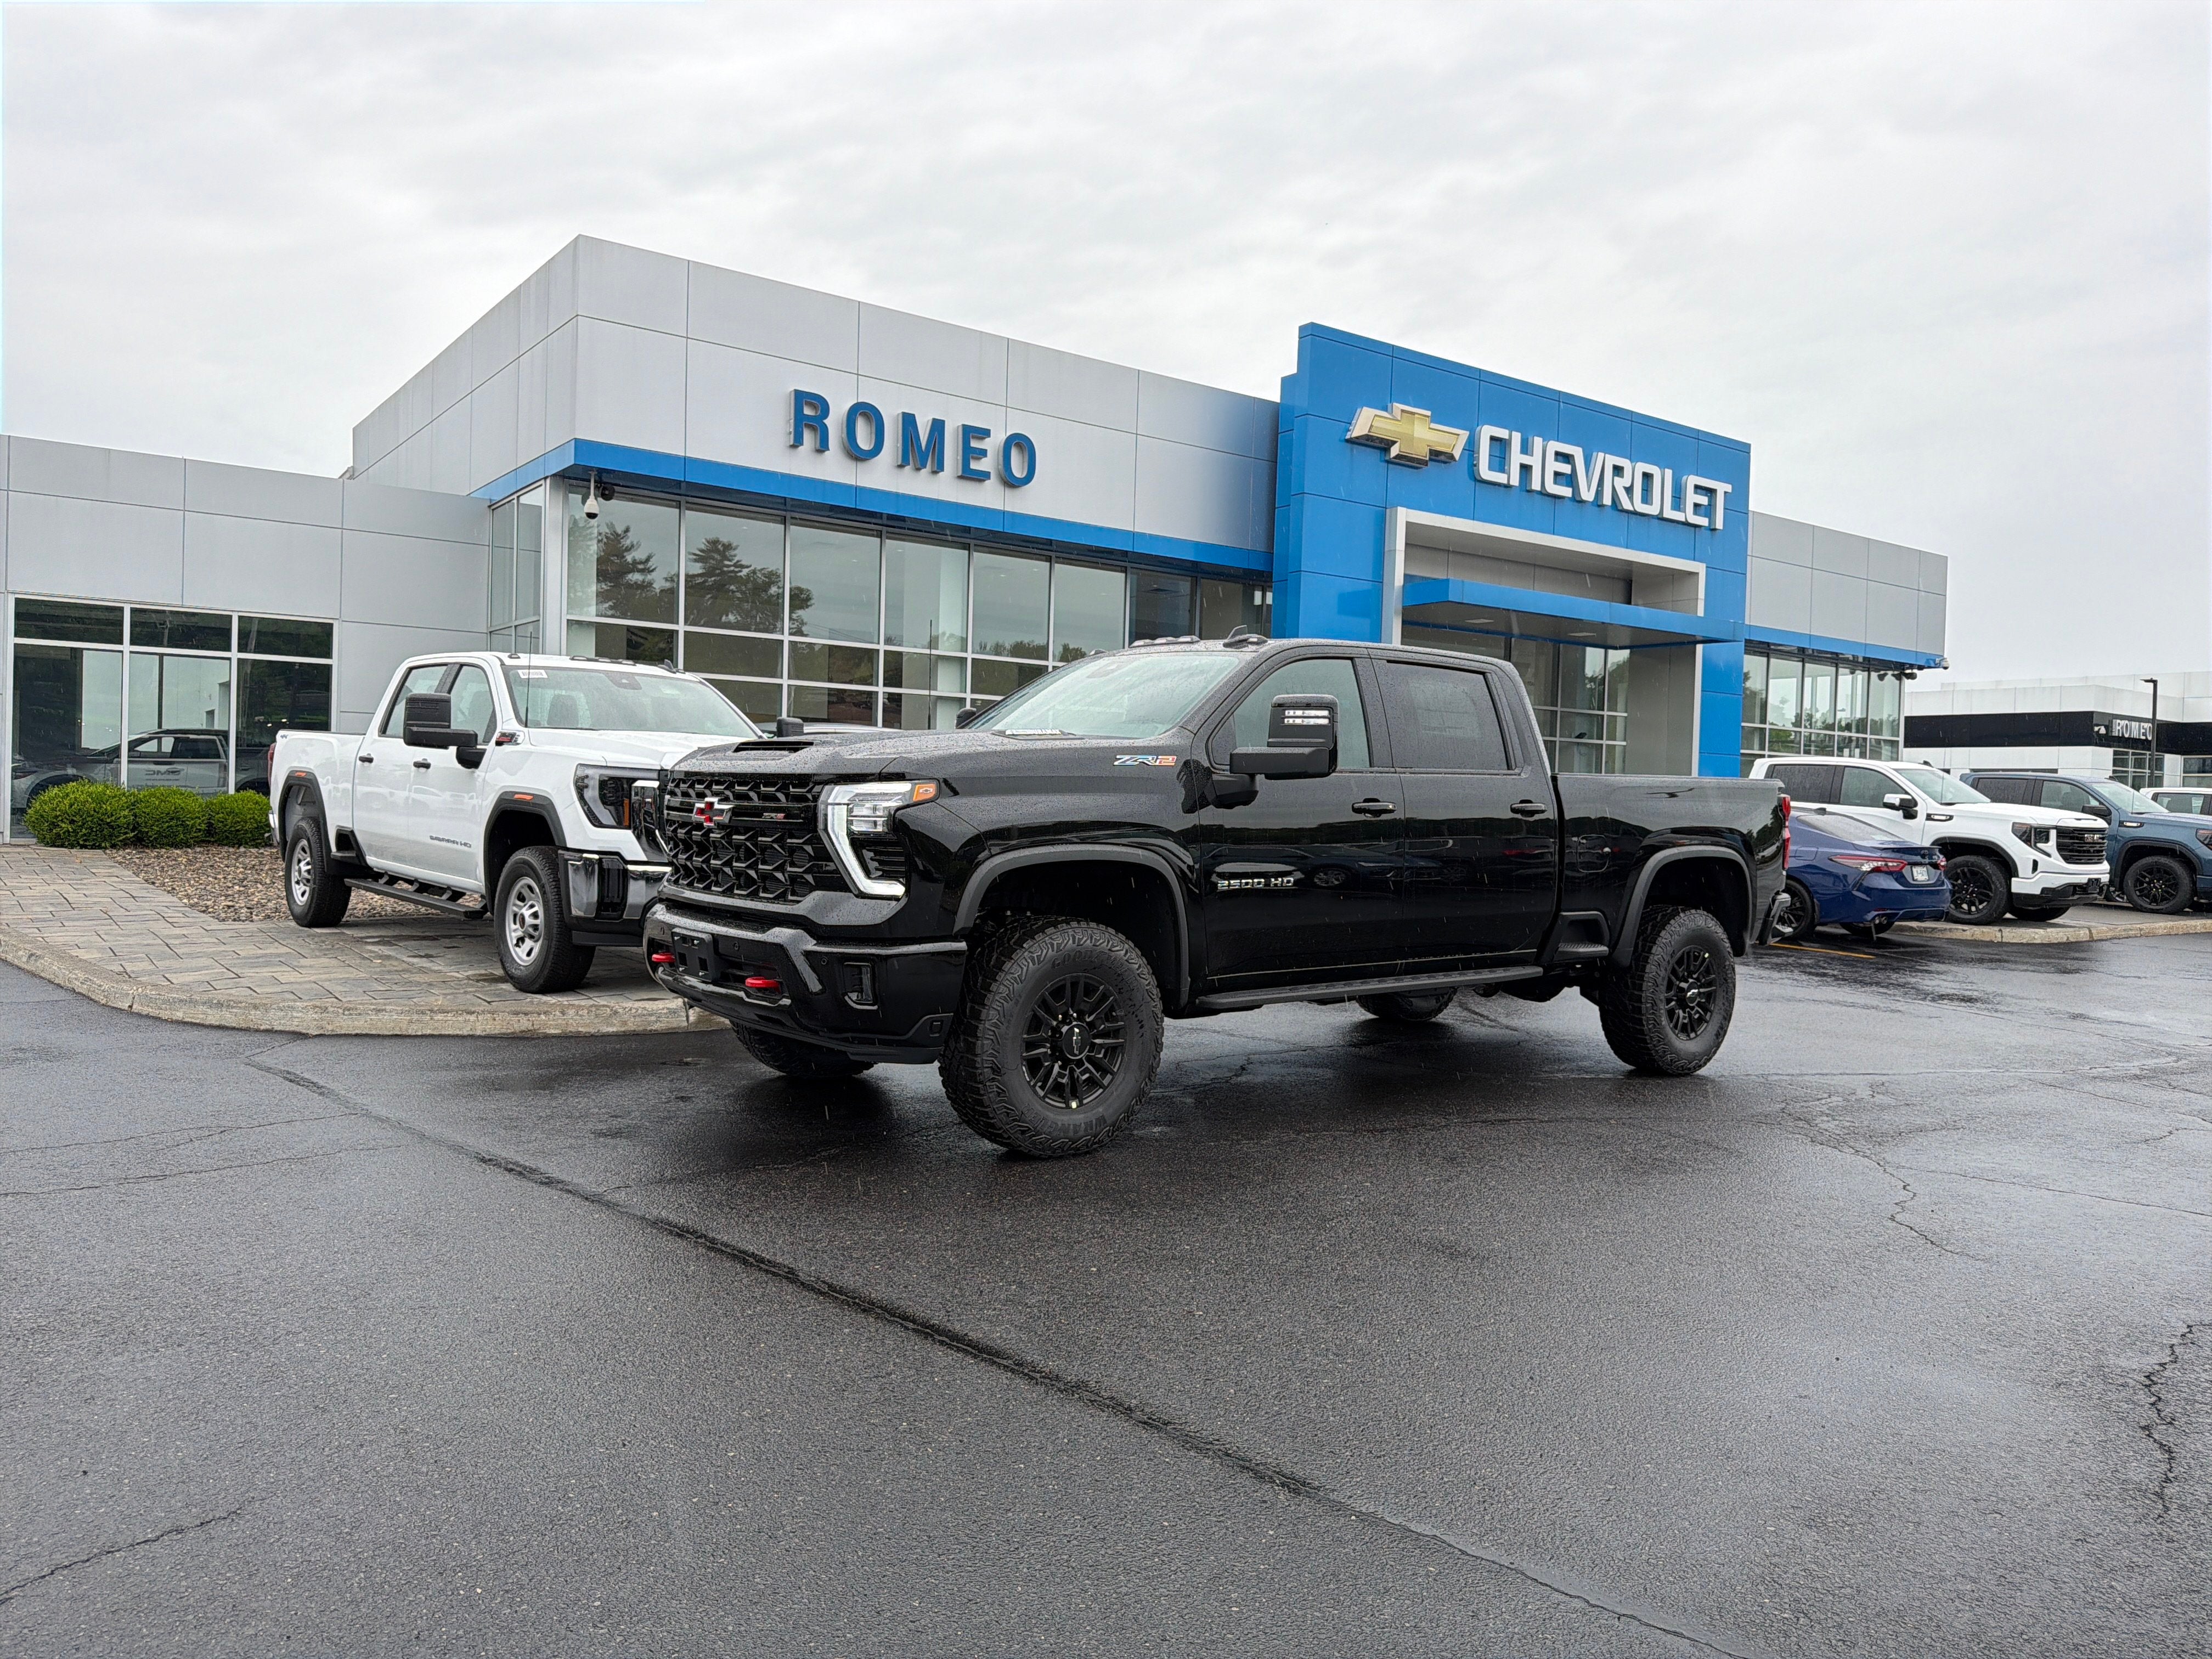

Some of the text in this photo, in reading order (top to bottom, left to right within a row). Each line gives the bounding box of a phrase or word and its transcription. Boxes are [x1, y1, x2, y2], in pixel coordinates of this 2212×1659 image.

[789, 389, 1036, 487] ROMEO
[1474, 425, 1732, 531] CHEVROLET
[2112, 719, 2152, 741] ROMEO
[1113, 754, 1177, 766] ZR2
[1217, 877, 1294, 890] 2500 HD
